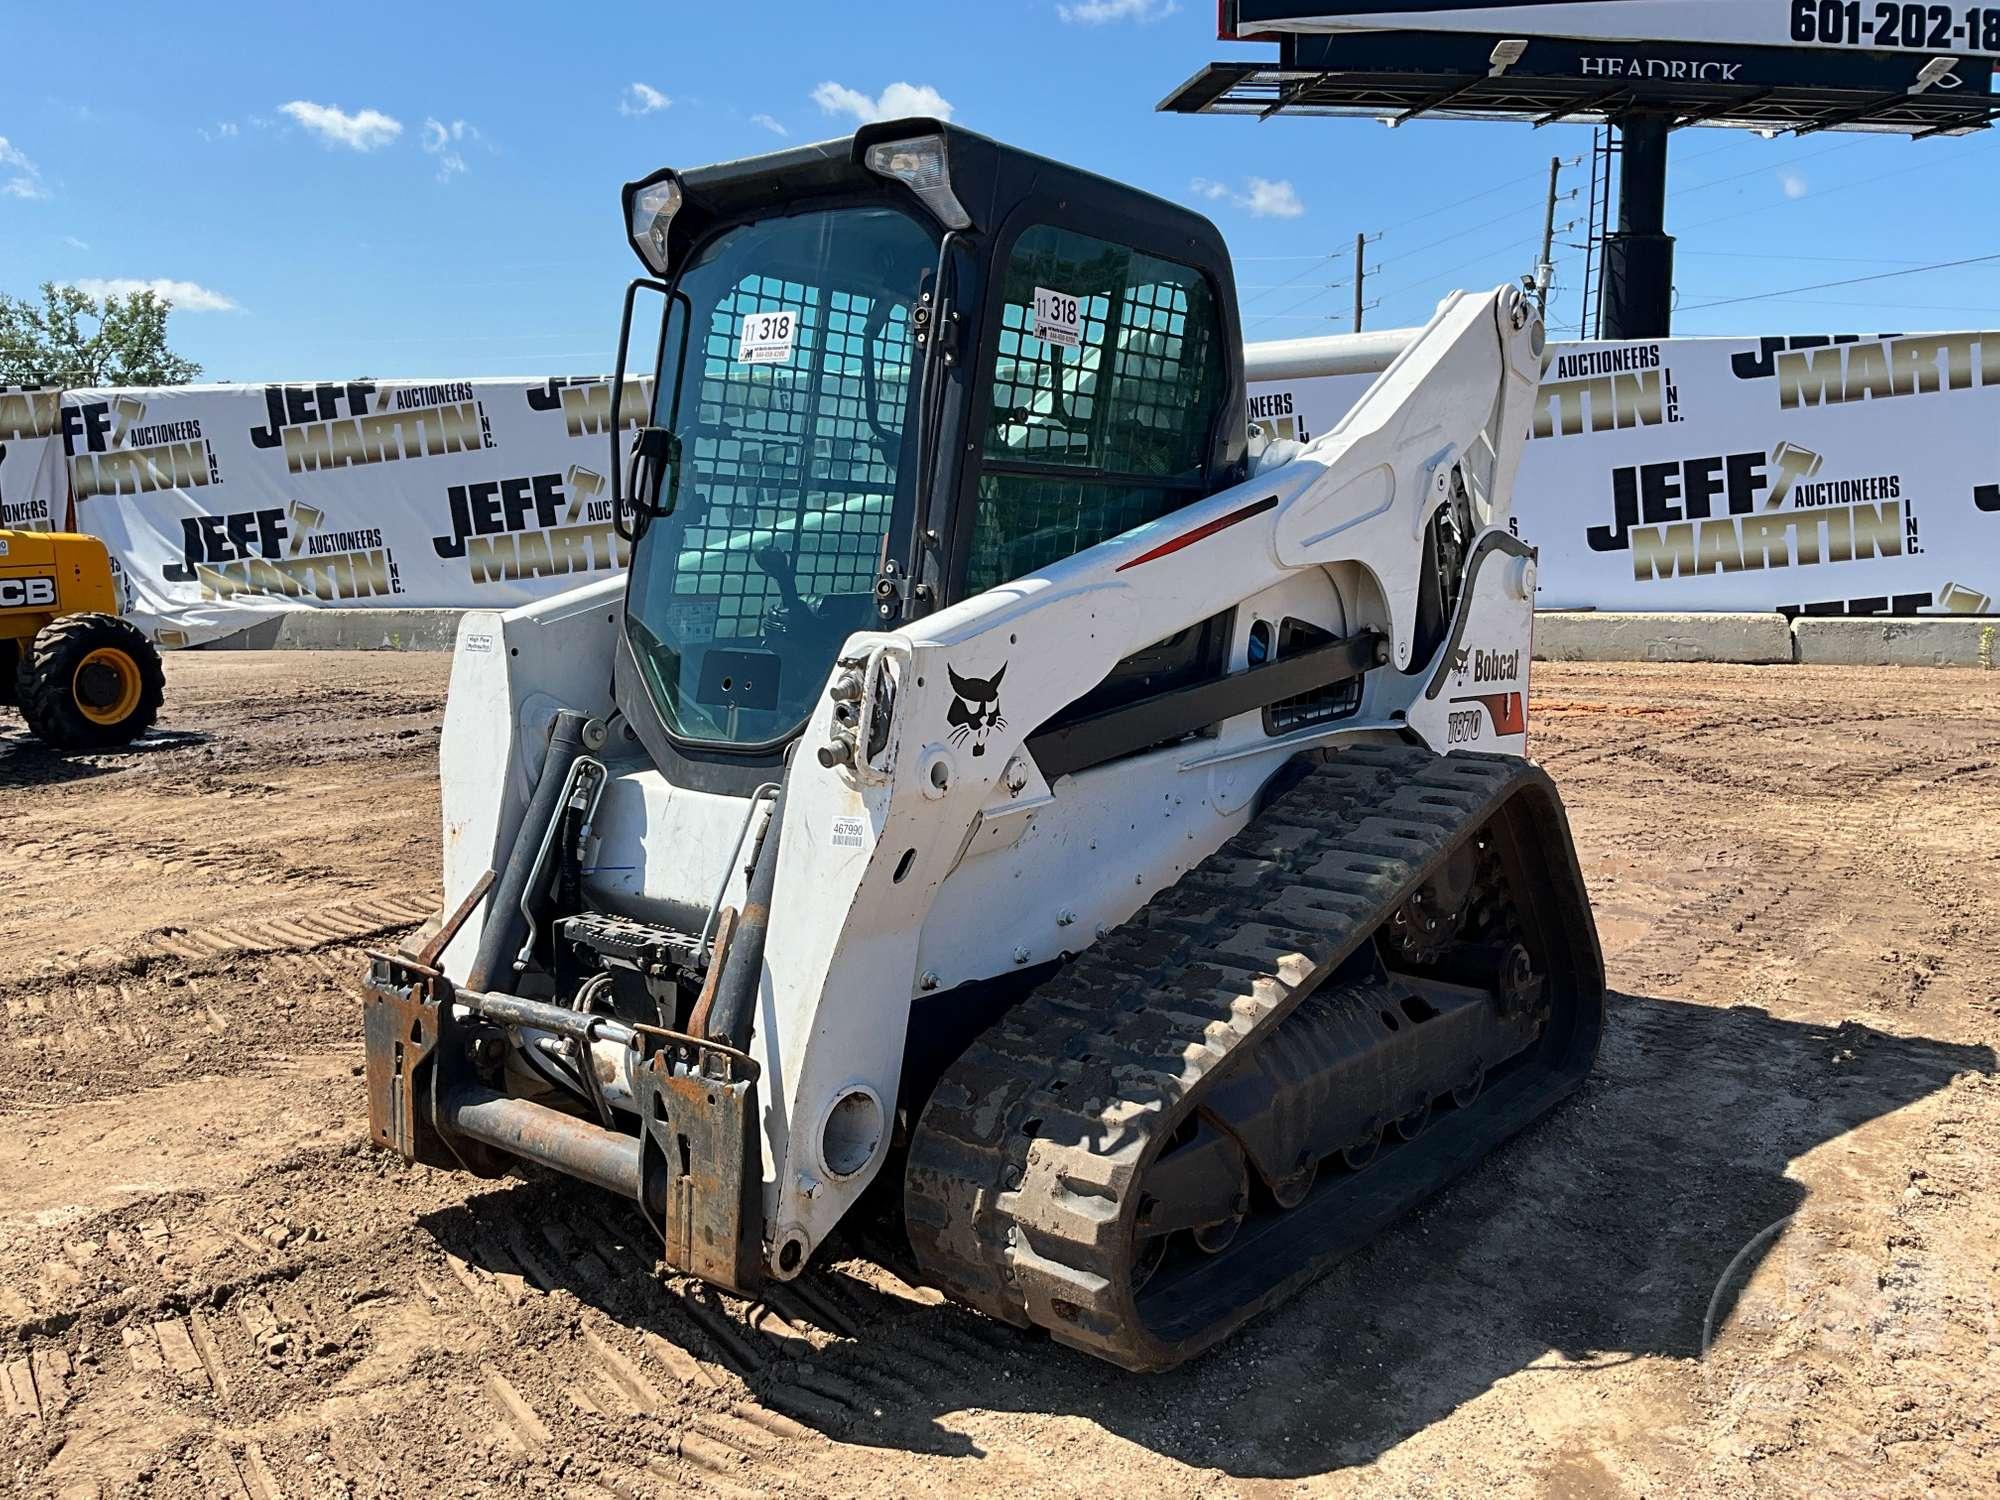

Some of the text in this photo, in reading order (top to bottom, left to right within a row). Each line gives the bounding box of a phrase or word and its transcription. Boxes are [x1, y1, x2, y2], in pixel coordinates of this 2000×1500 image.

[1579, 57, 1742, 80] HEADRICK
[1050, 296, 1077, 325] 318
[759, 316, 790, 340] 318
[1558, 344, 1660, 379] AUCTIONEERS
[396, 382, 473, 410] AUCTIONEERS
[131, 420, 201, 447] AUCTIONEERS
[283, 403, 482, 474] MARTIN
[1587, 452, 1767, 551] JEFF
[1794, 475, 1900, 508] AUCTIONEERS
[433, 474, 566, 558] JEFF
[163, 508, 288, 582] JEFF
[308, 528, 382, 554] AUCTIONEERS
[1632, 501, 1902, 581] MARTIN
[199, 550, 390, 600] MARTIN
[1474, 649, 1519, 682] Bobcat
[1448, 710, 1482, 744] T870
[833, 823, 863, 835] 467990
